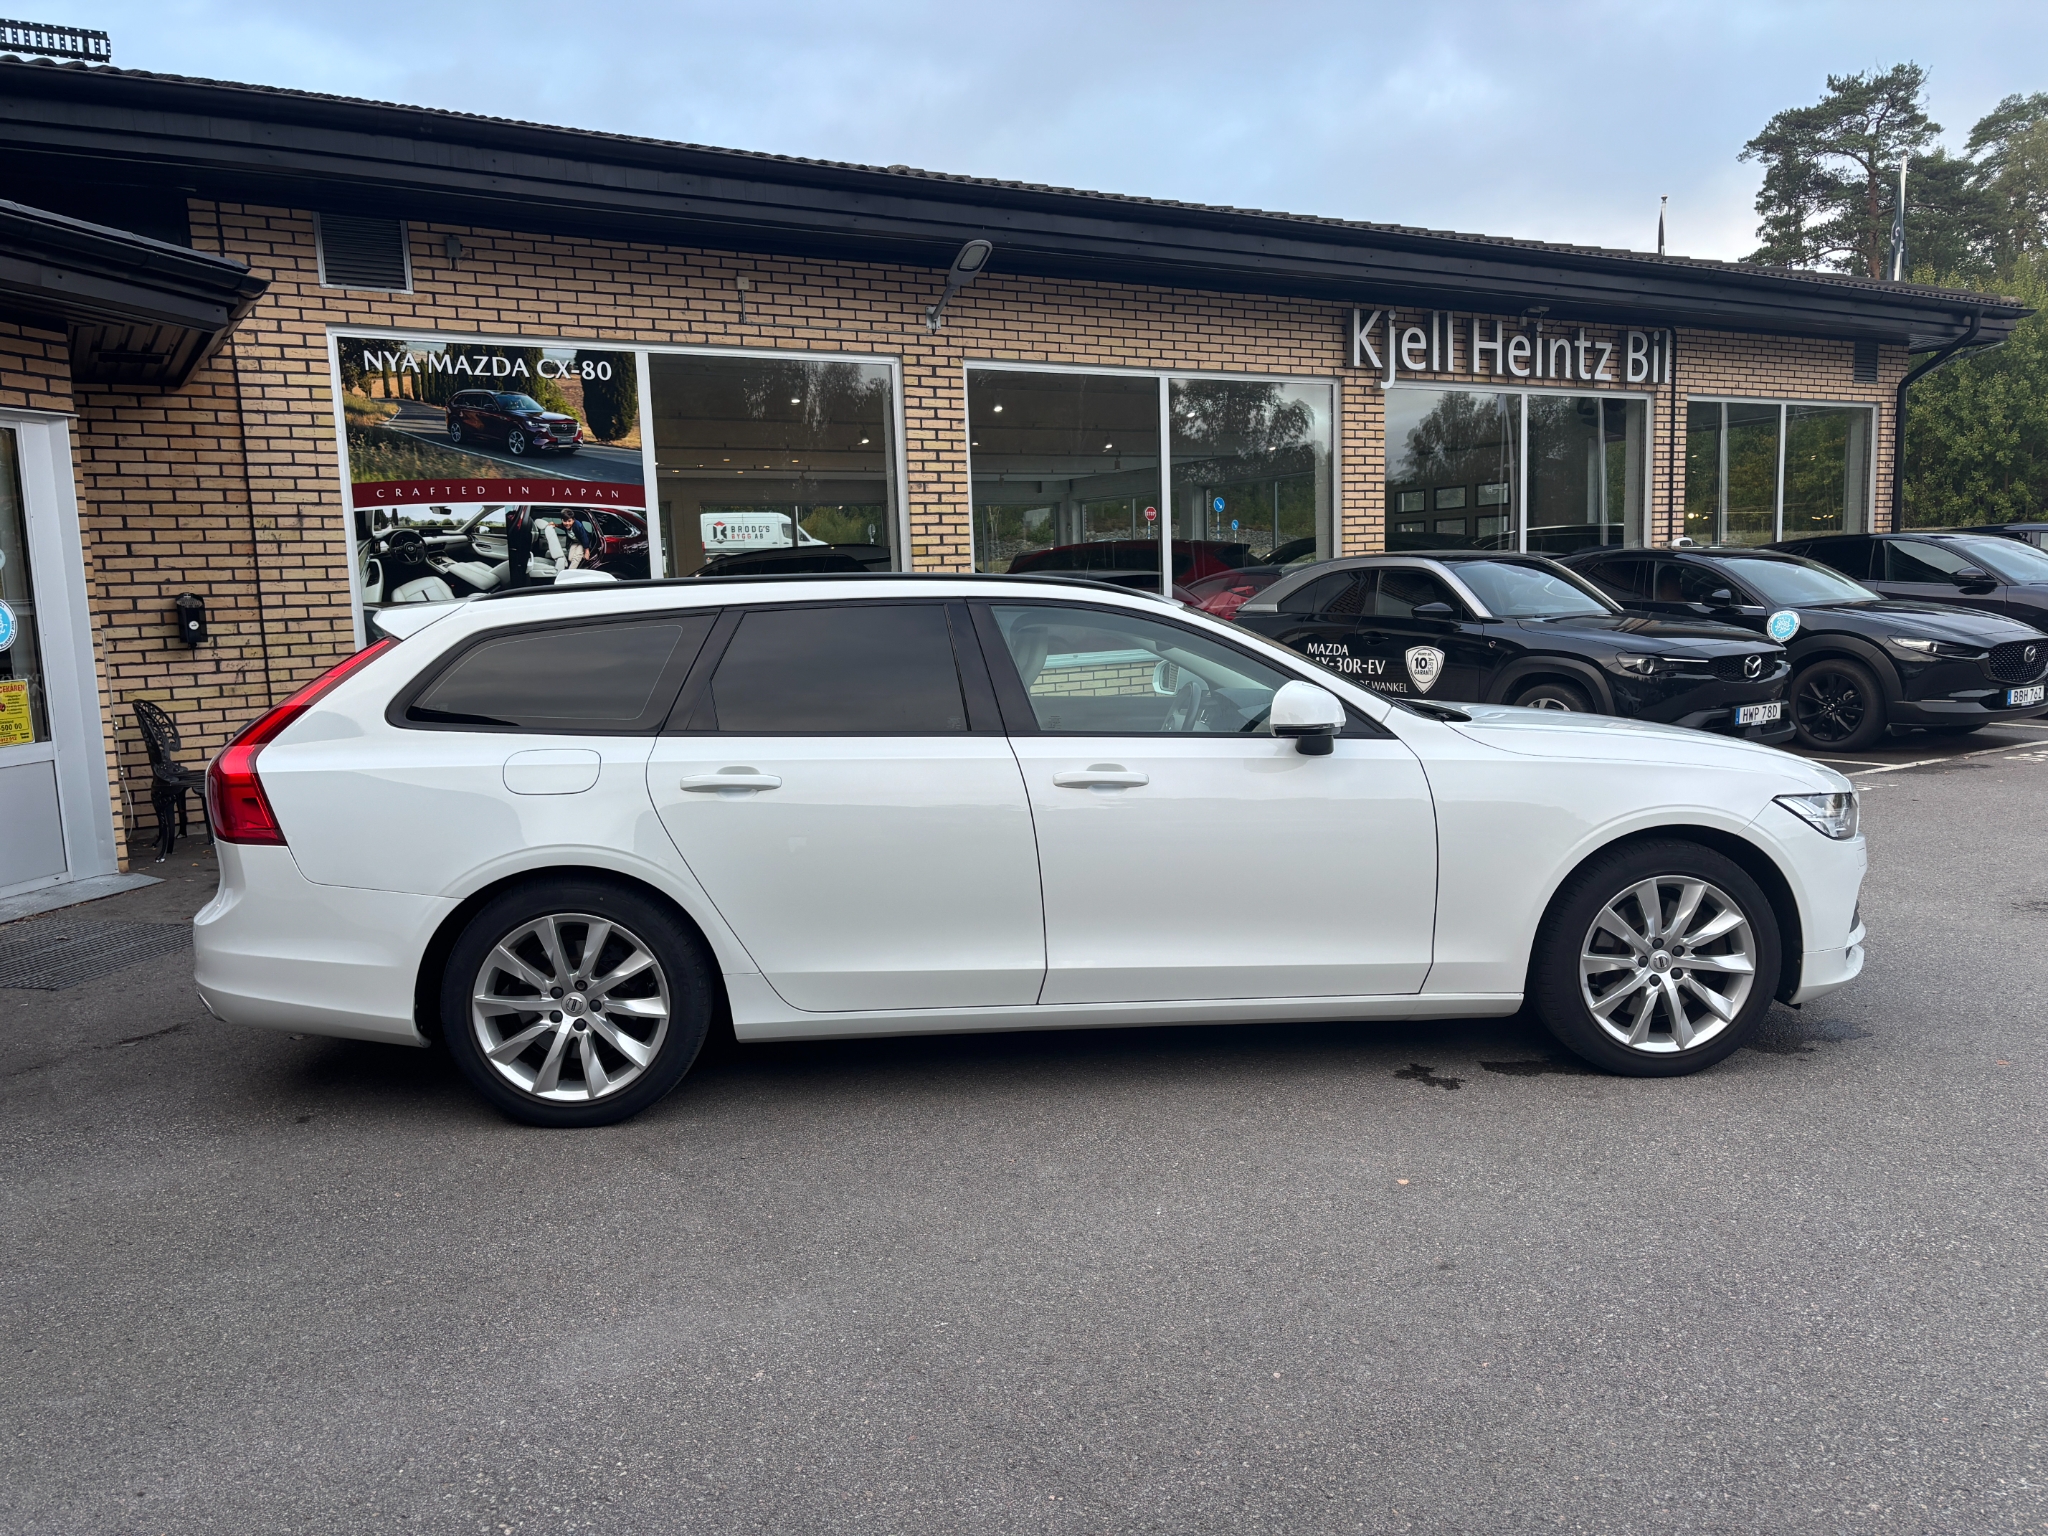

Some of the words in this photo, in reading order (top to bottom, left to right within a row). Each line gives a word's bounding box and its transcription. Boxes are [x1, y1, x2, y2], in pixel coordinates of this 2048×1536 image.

[1350, 308, 1454, 389] Kjell
[1472, 318, 1613, 381] Heintz
[1627, 330, 1671, 383] Bil
[363, 350, 421, 374] NYA
[428, 354, 530, 378] MAZDA
[536, 358, 612, 381] CX-80
[376, 486, 486, 498] CRAFTED
[508, 486, 530, 496] IN
[551, 487, 619, 498] JAPAN
[1306, 642, 1349, 656] MAZDA
[1414, 657, 1428, 670] 10
[1371, 681, 1408, 693] WANKEL
[2013, 689, 2029, 703] BBH
[1742, 707, 1760, 722] HWP
[1761, 704, 1778, 719] 78D
